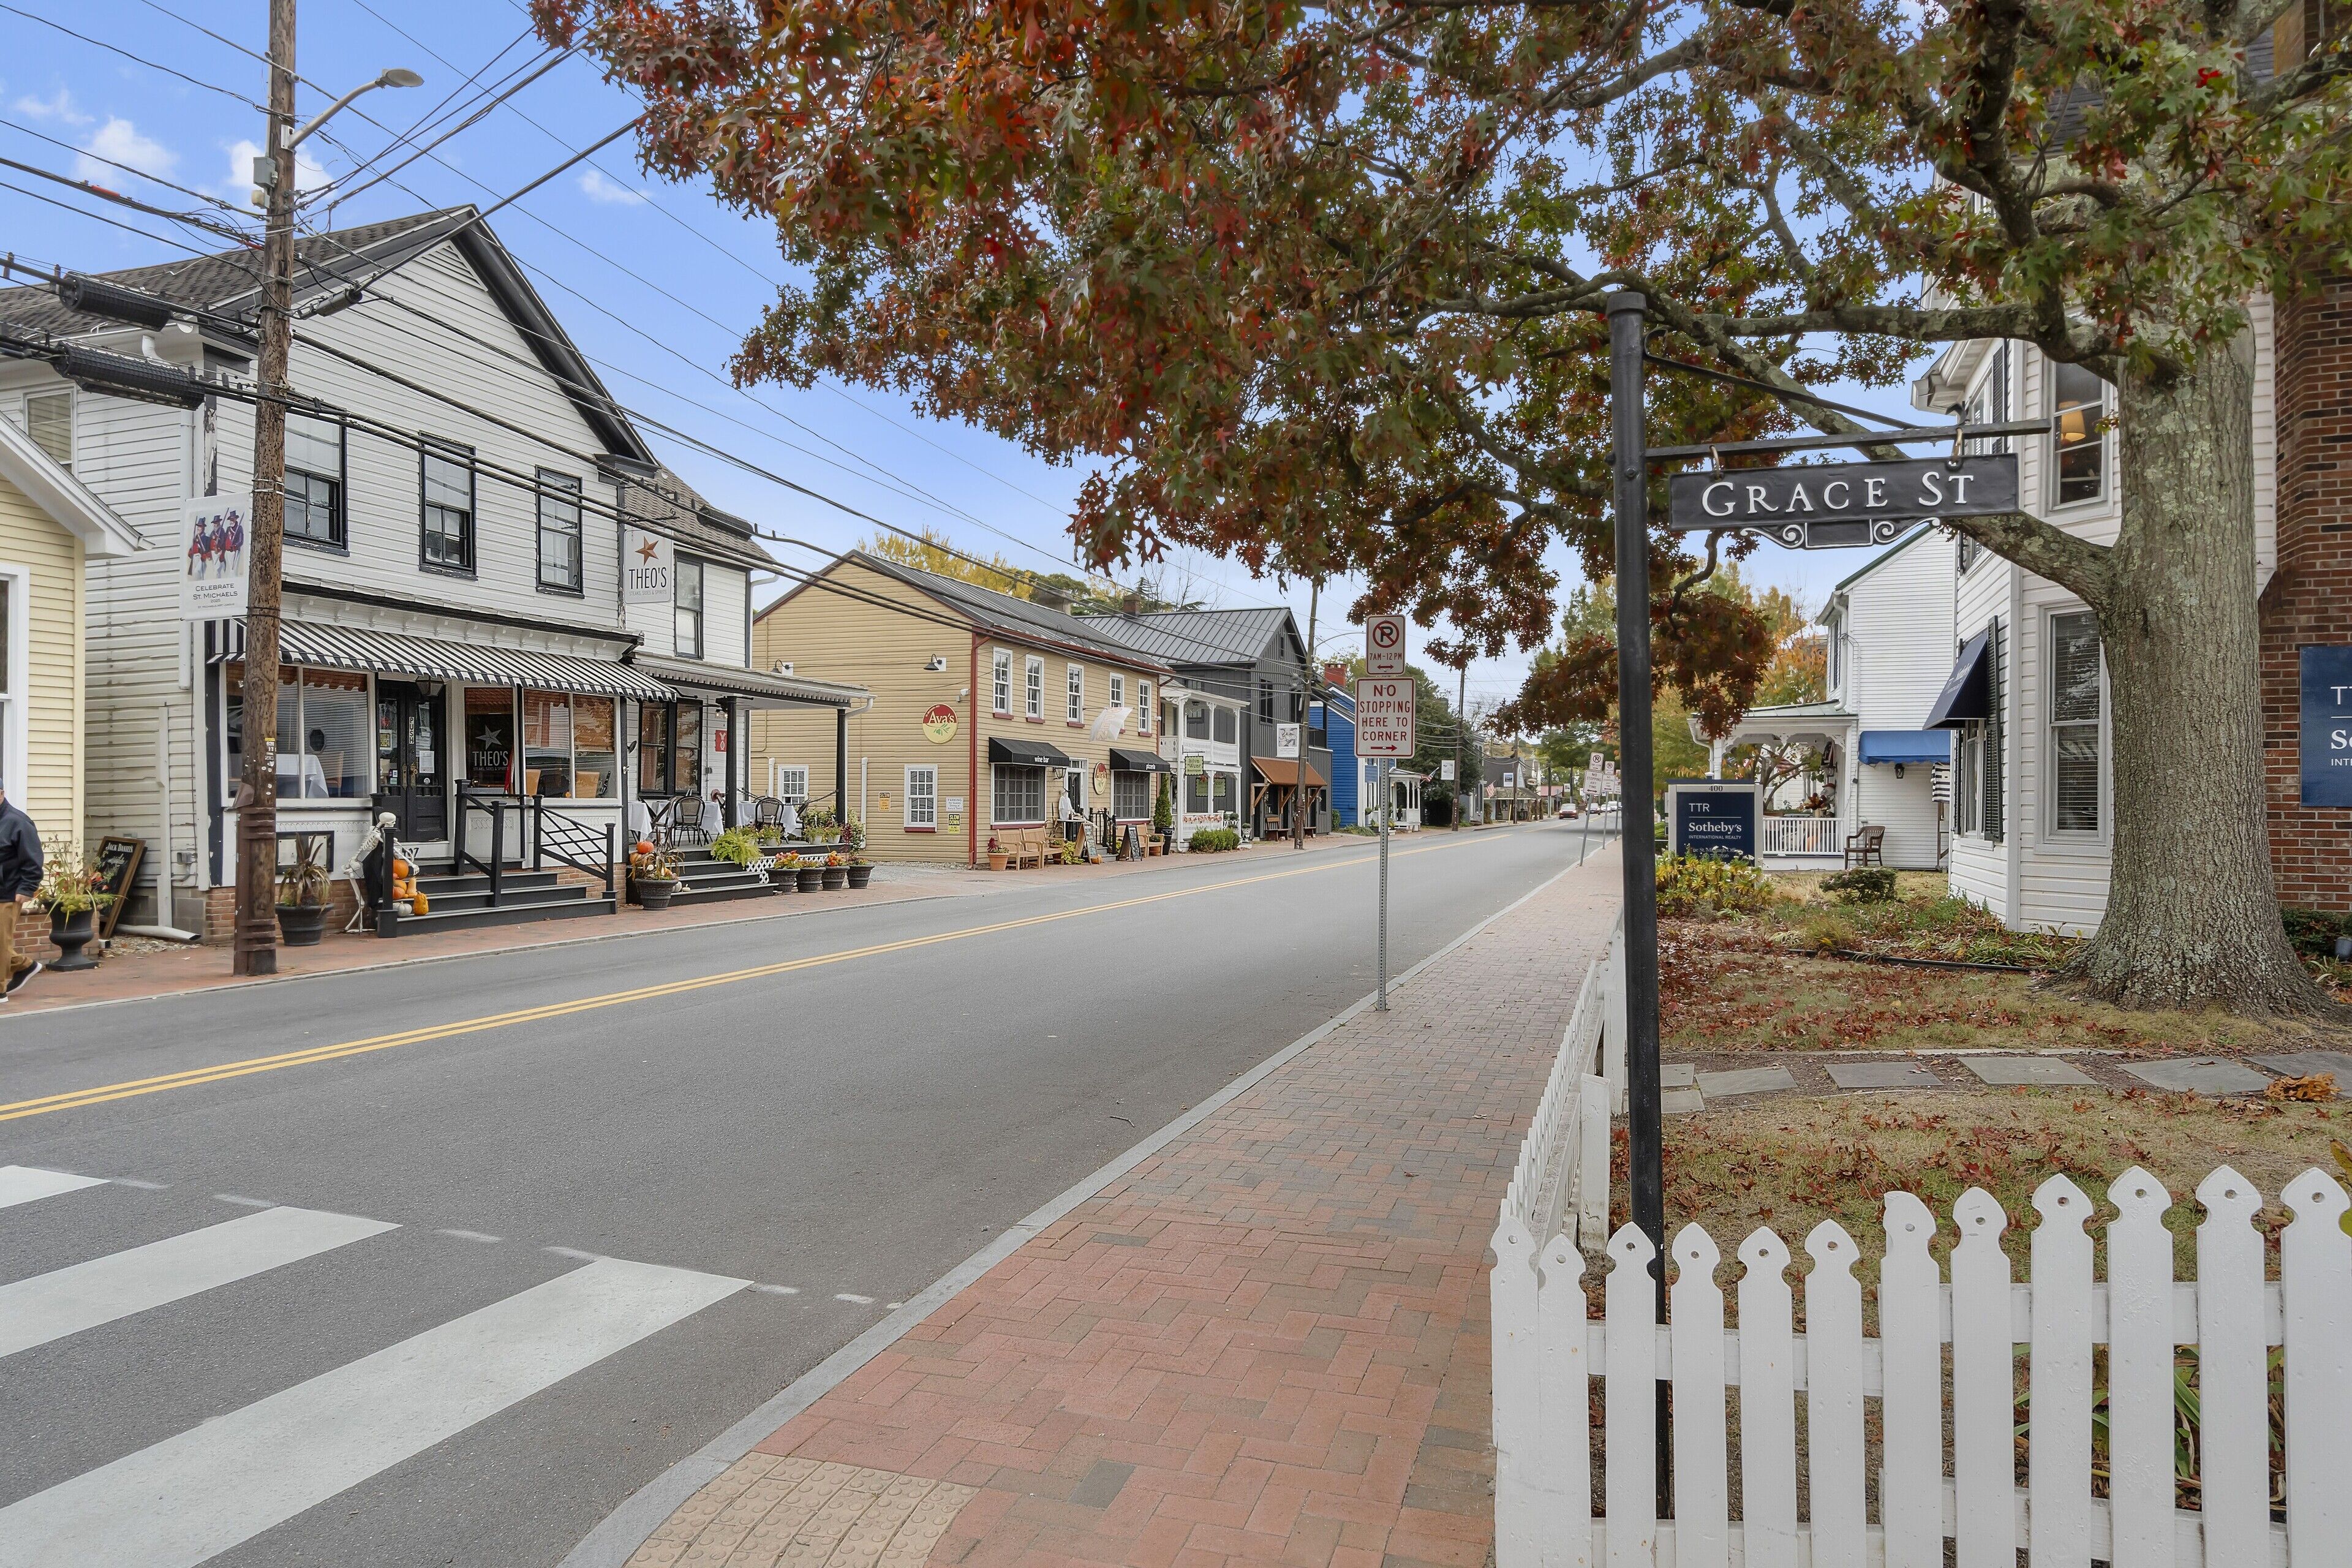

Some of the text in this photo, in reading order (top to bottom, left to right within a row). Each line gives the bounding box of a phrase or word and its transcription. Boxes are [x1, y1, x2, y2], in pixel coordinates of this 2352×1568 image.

[1702, 472, 1973, 516] GRACE ST
[628, 567, 666, 589] THEO'S
[195, 583, 235, 592] CELEBRATE
[1373, 685, 1396, 696] NO
[1360, 701, 1410, 713] STOPPING
[928, 710, 954, 724] Ava's
[1362, 717, 1408, 727] HERE TO
[1362, 731, 1407, 741] CORNER
[472, 751, 508, 766] THEO'S
[1689, 803, 1709, 812] TTR
[1689, 821, 1742, 834] Sotheby's
